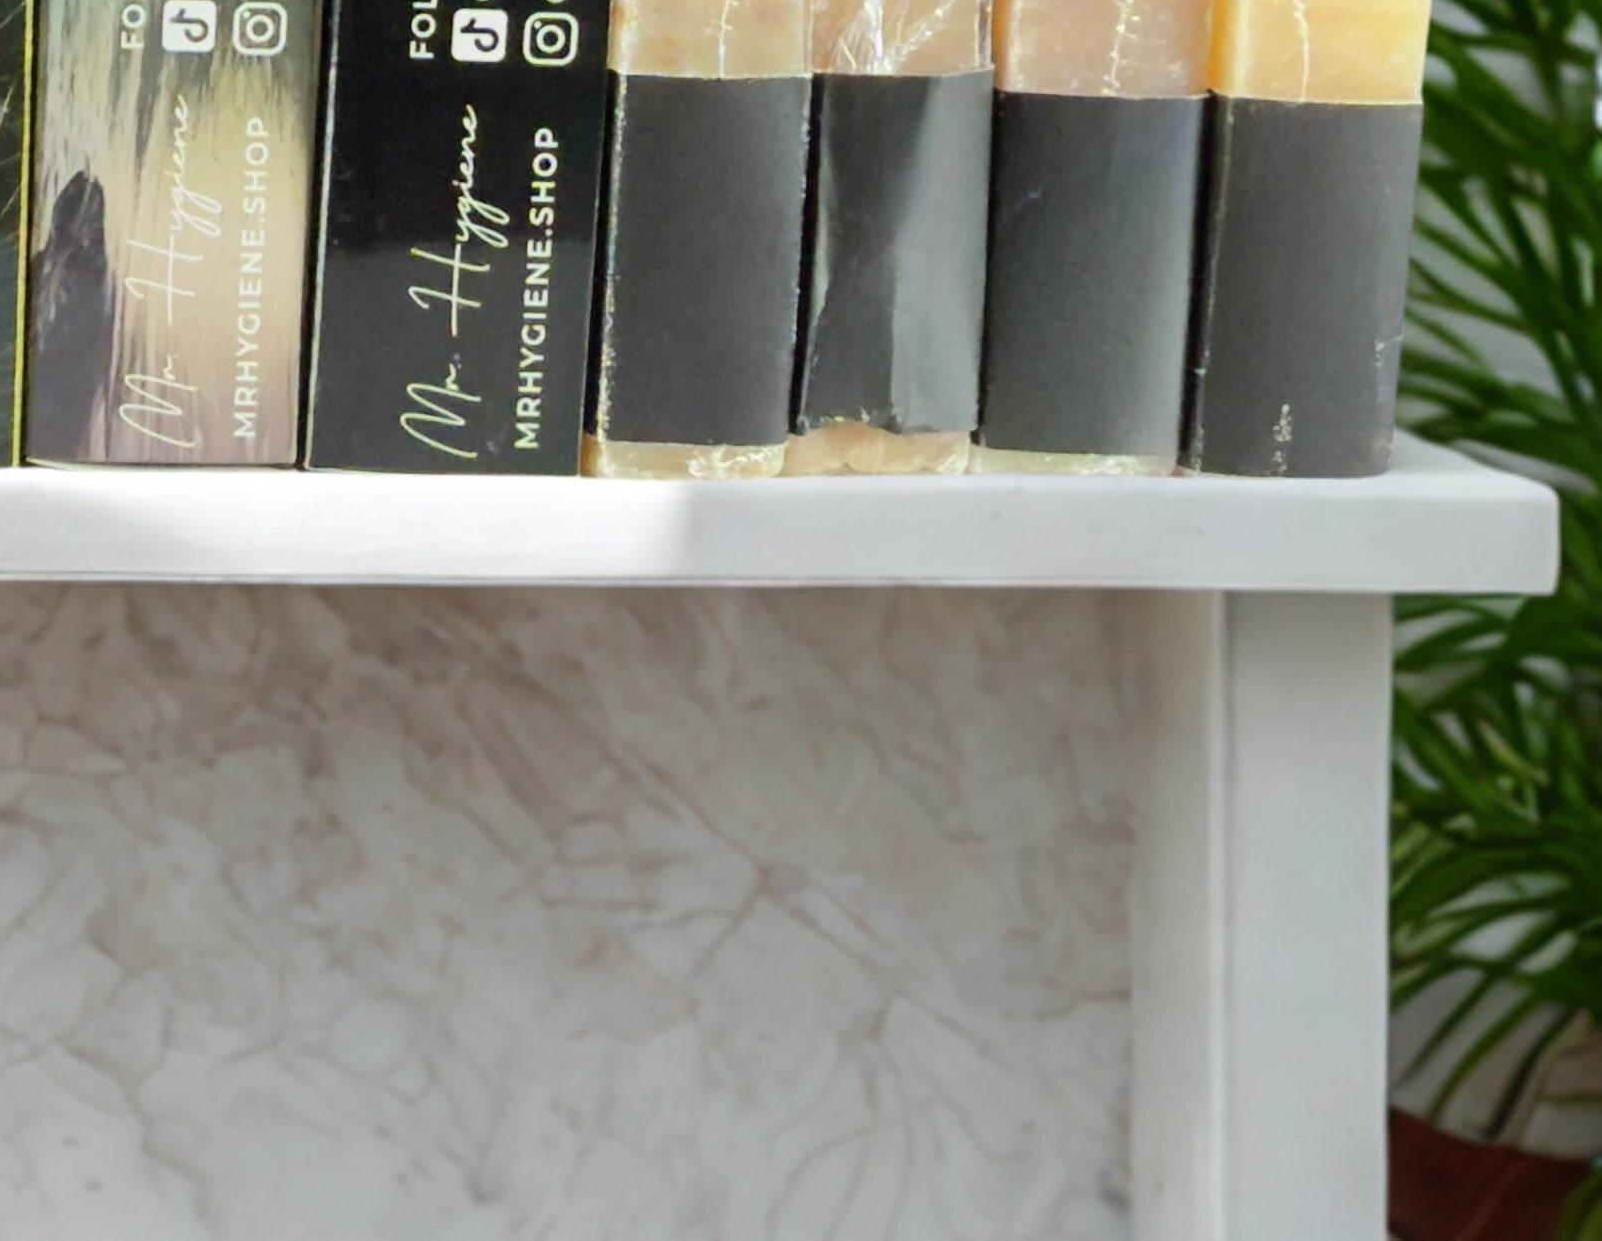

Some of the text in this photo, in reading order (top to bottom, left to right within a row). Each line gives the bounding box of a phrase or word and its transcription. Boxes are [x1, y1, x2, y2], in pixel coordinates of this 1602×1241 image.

[125, 94, 223, 325] Hygiene
[233, 117, 269, 438] MRHYGIENE.SHOP
[408, 104, 510, 337] Hygiene
[514, 127, 559, 449] MRHYGIENE.SHOP
